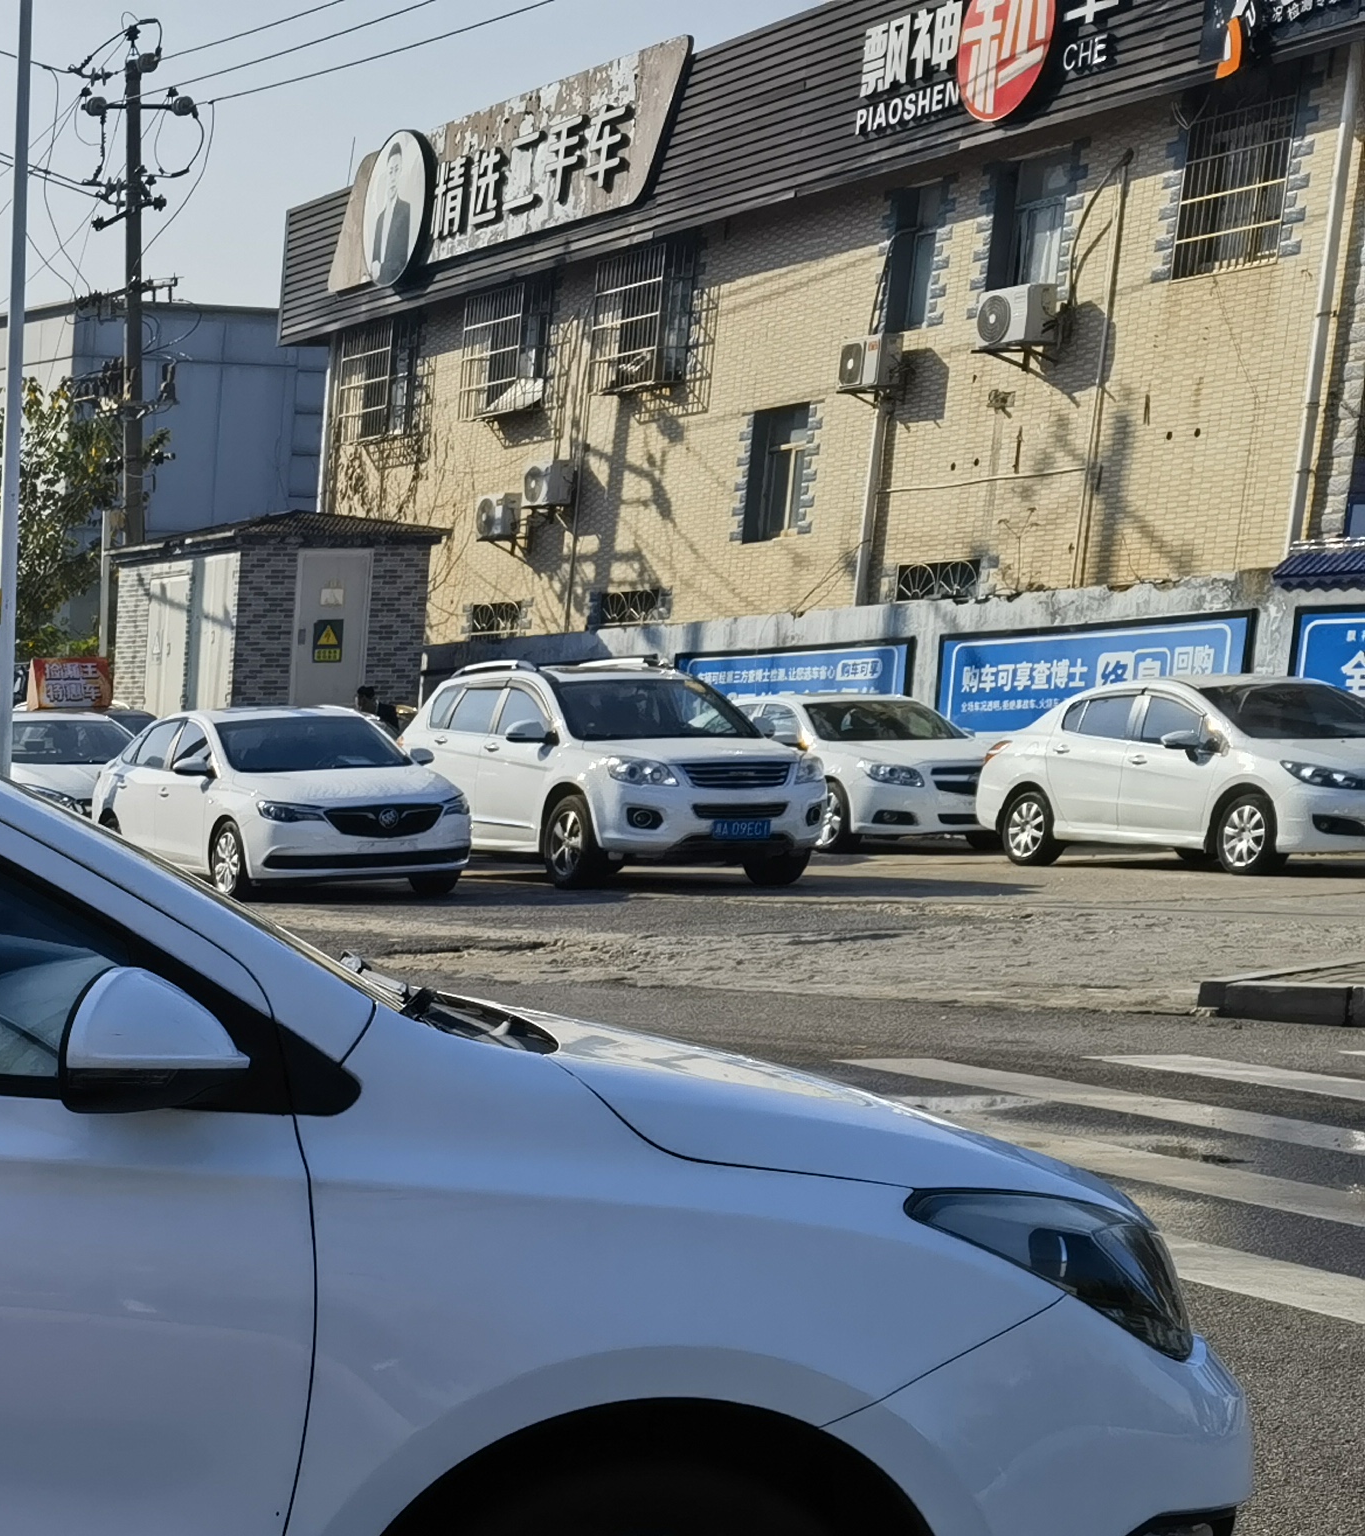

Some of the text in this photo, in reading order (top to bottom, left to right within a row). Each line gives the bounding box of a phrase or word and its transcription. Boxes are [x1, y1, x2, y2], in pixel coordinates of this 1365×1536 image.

[855, 34, 1109, 136] PIAOSHEN CHE
[430, 102, 627, 240] 精选二手车
[960, 658, 1089, 693] 购车可享查博士
